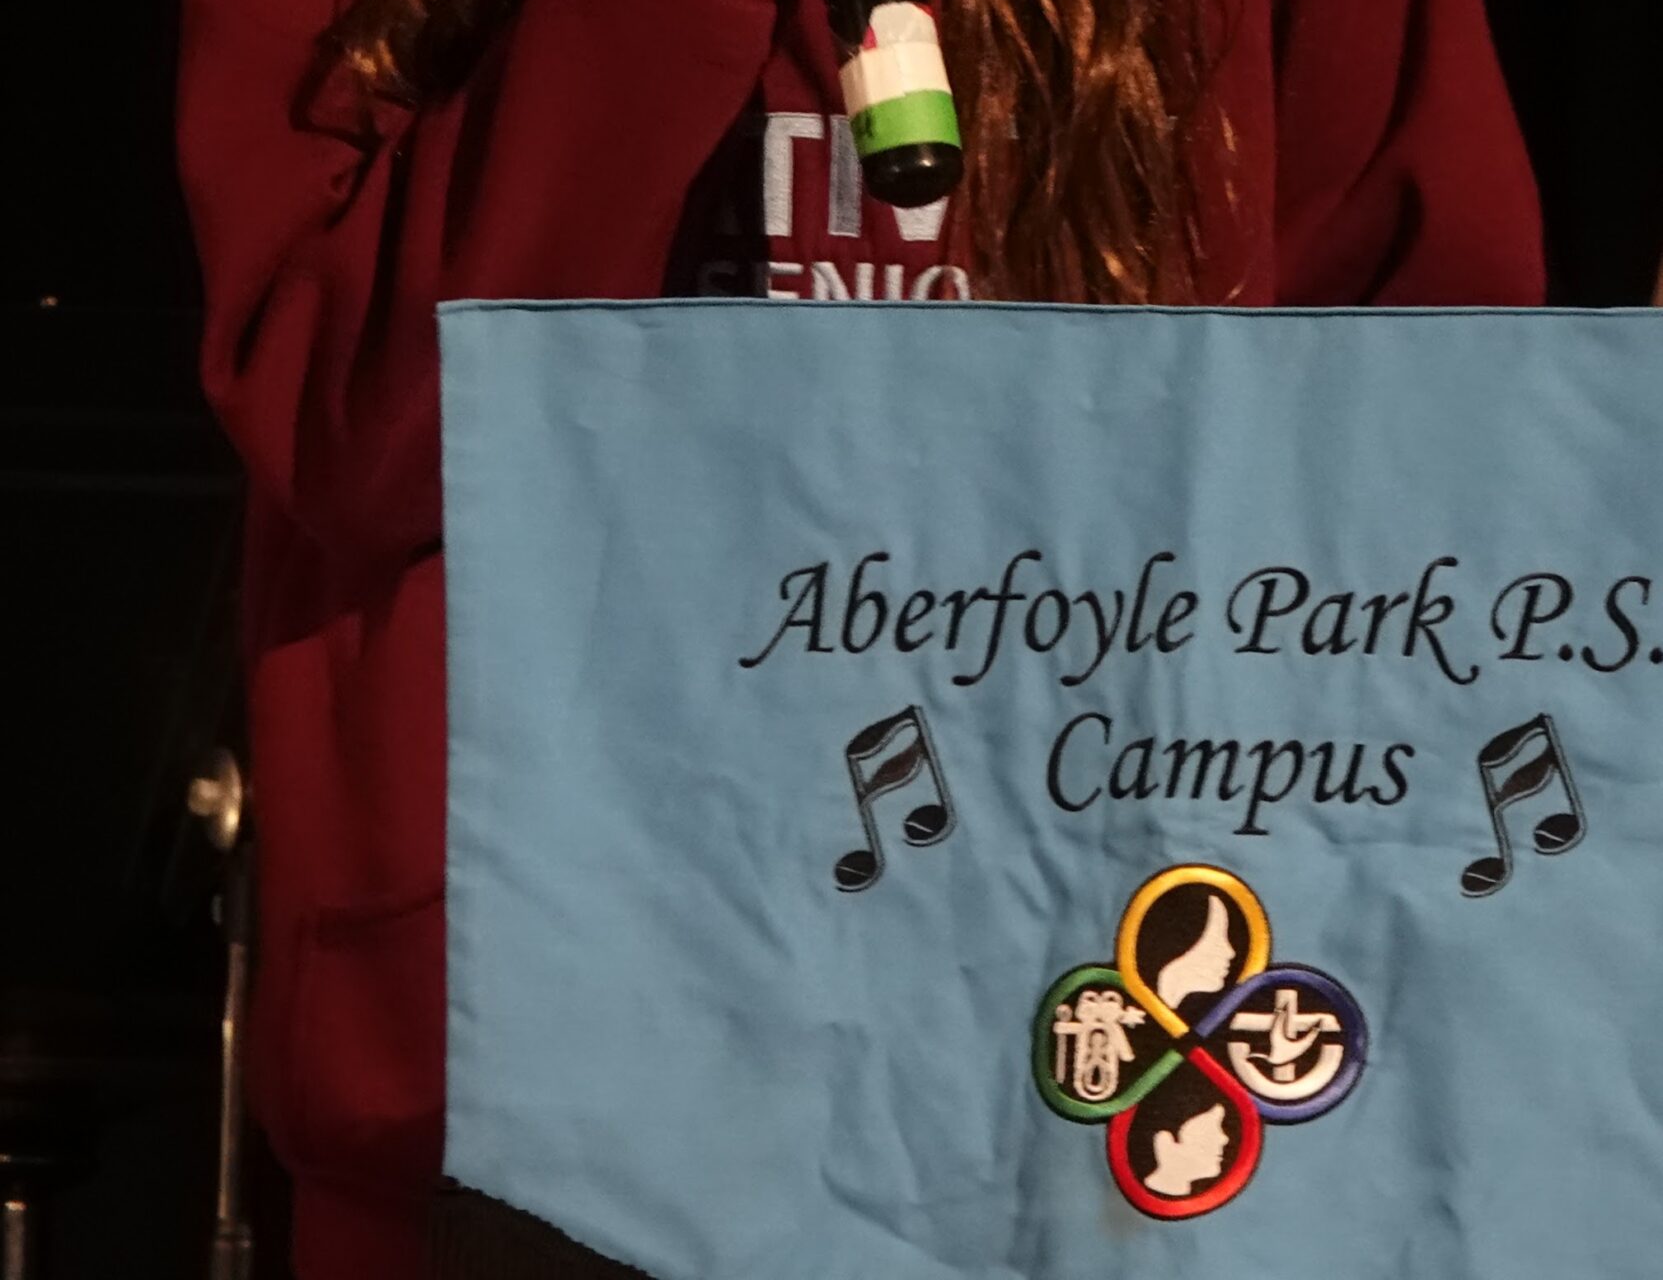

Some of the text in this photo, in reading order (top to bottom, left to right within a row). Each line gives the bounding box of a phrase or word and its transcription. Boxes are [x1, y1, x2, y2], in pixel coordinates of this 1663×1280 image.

[738, 549, 1663, 687] Aberfoyle Park P.S.
[1046, 712, 1415, 837] Campus
